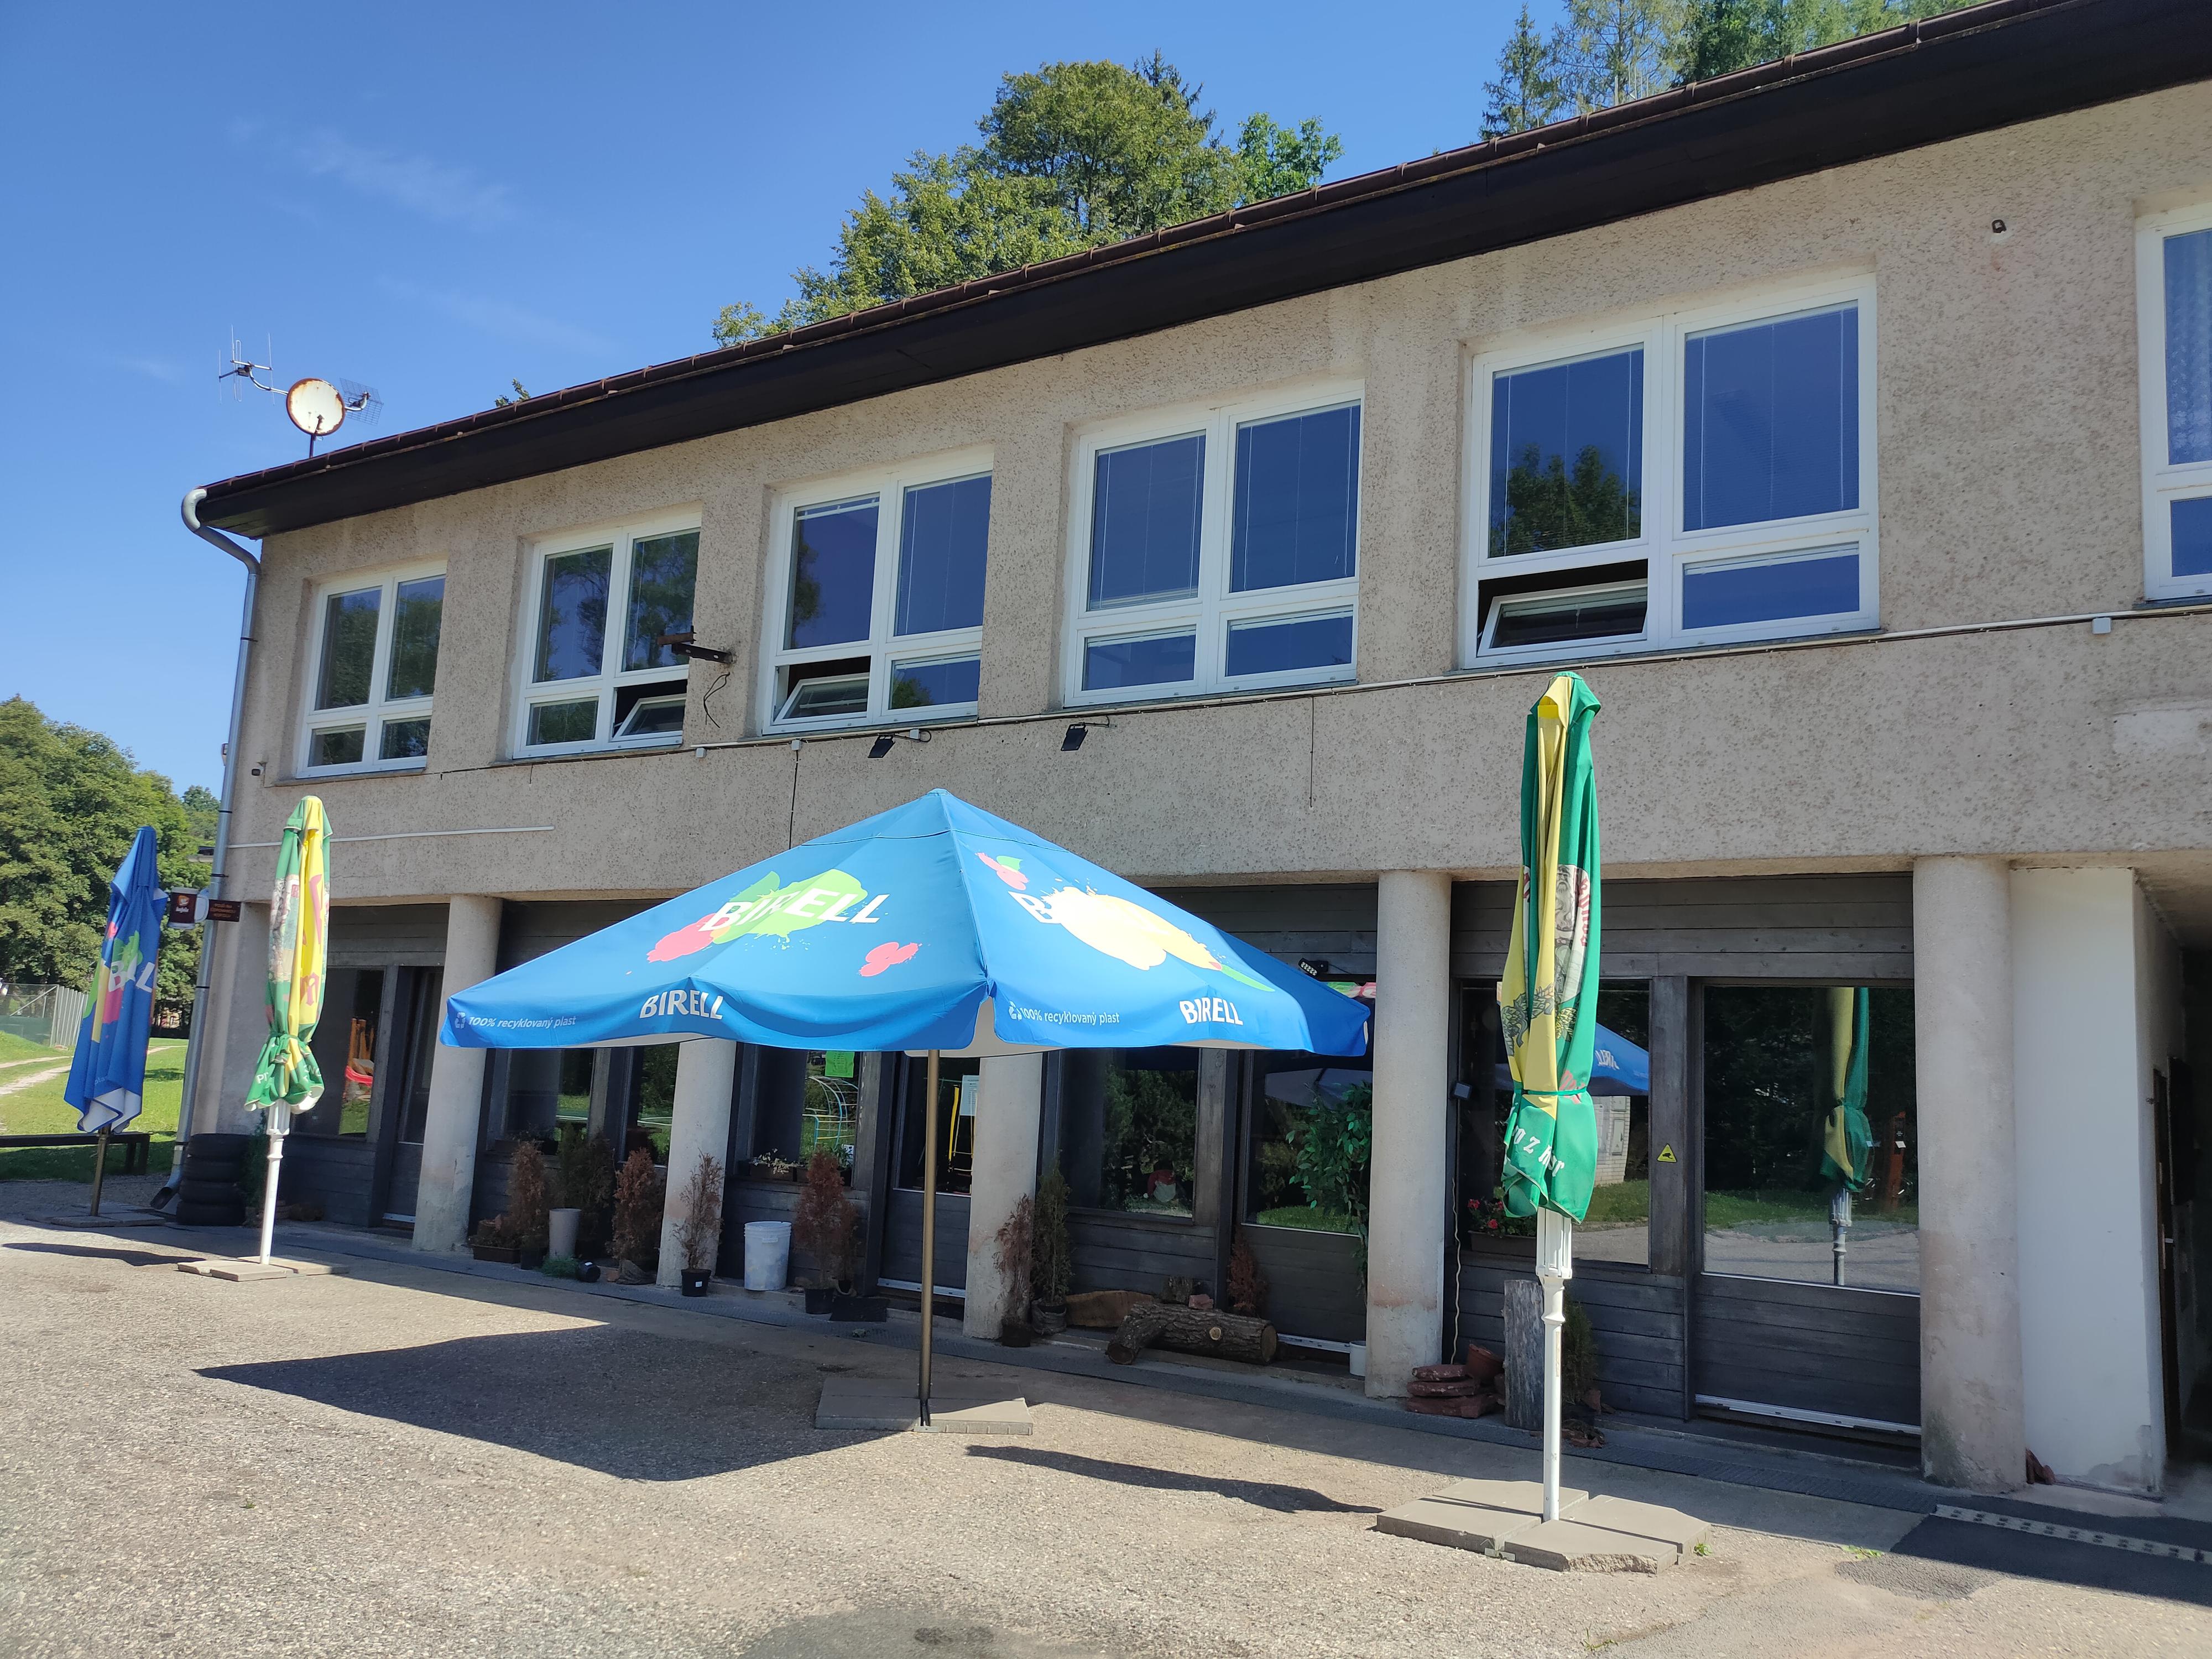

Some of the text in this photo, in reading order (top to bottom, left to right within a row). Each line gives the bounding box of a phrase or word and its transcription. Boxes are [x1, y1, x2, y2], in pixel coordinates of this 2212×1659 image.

[698, 888, 890, 932] BIRELL
[639, 989, 724, 1020] BIRELL
[1020, 1008, 1120, 1026] 100% recyklovaný plast
[1179, 997, 1244, 1026] BIRELL
[469, 1015, 576, 1029] 100% recyklovaný plast
